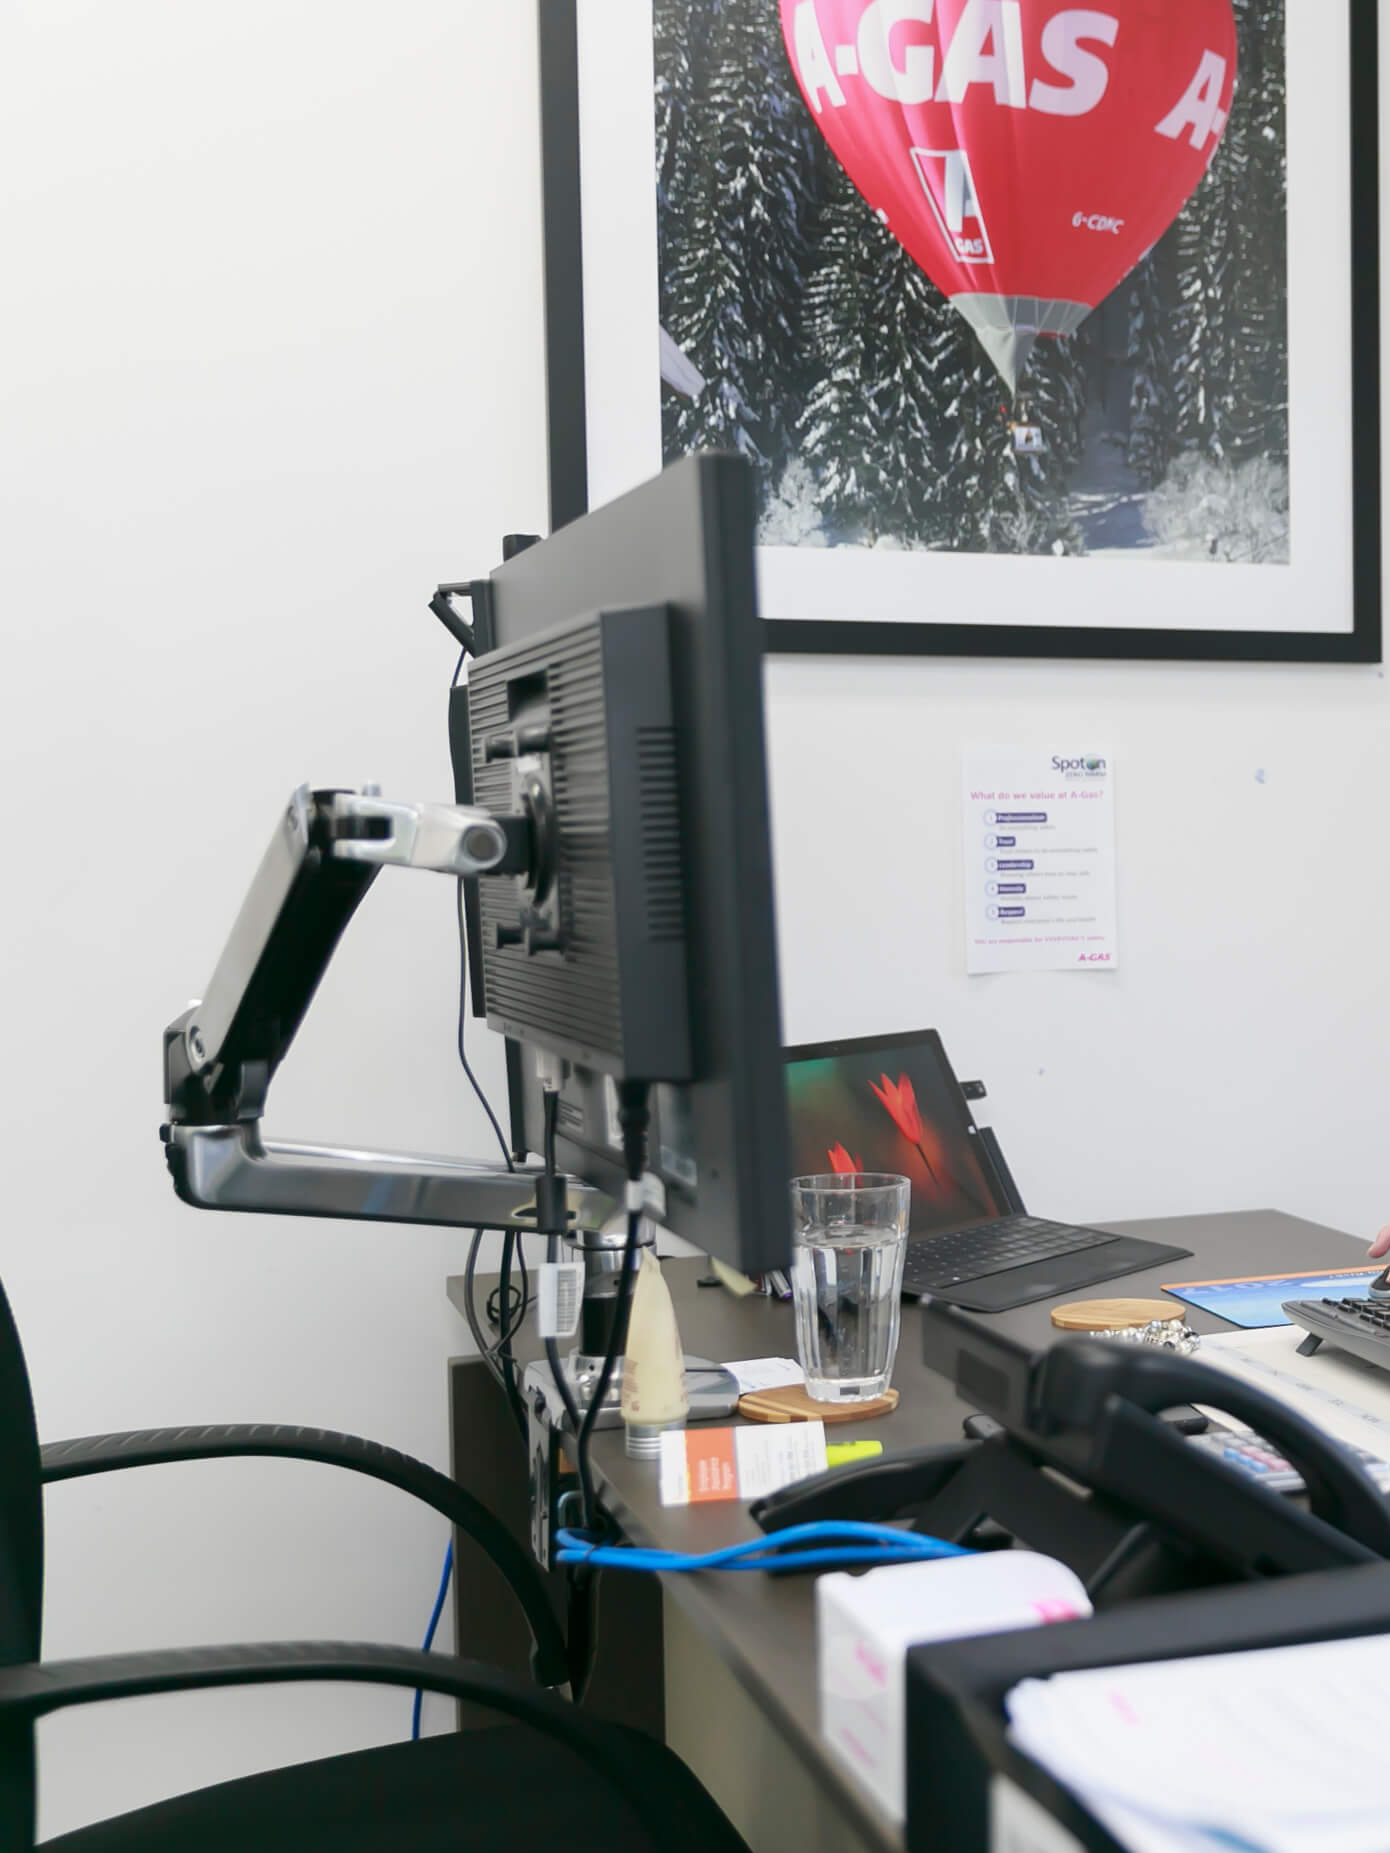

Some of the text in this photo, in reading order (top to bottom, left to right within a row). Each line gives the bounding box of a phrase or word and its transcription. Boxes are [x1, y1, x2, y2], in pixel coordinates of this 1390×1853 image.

[794, 0, 1119, 116] A-GAS
[955, 237, 984, 255] GAS
[970, 791, 995, 800] What
[998, 791, 1010, 800] do
[1013, 792, 1027, 800] we
[1030, 791, 1056, 800] value
[1058, 791, 1067, 800] at
[1078, 953, 1111, 962] A-GAS
